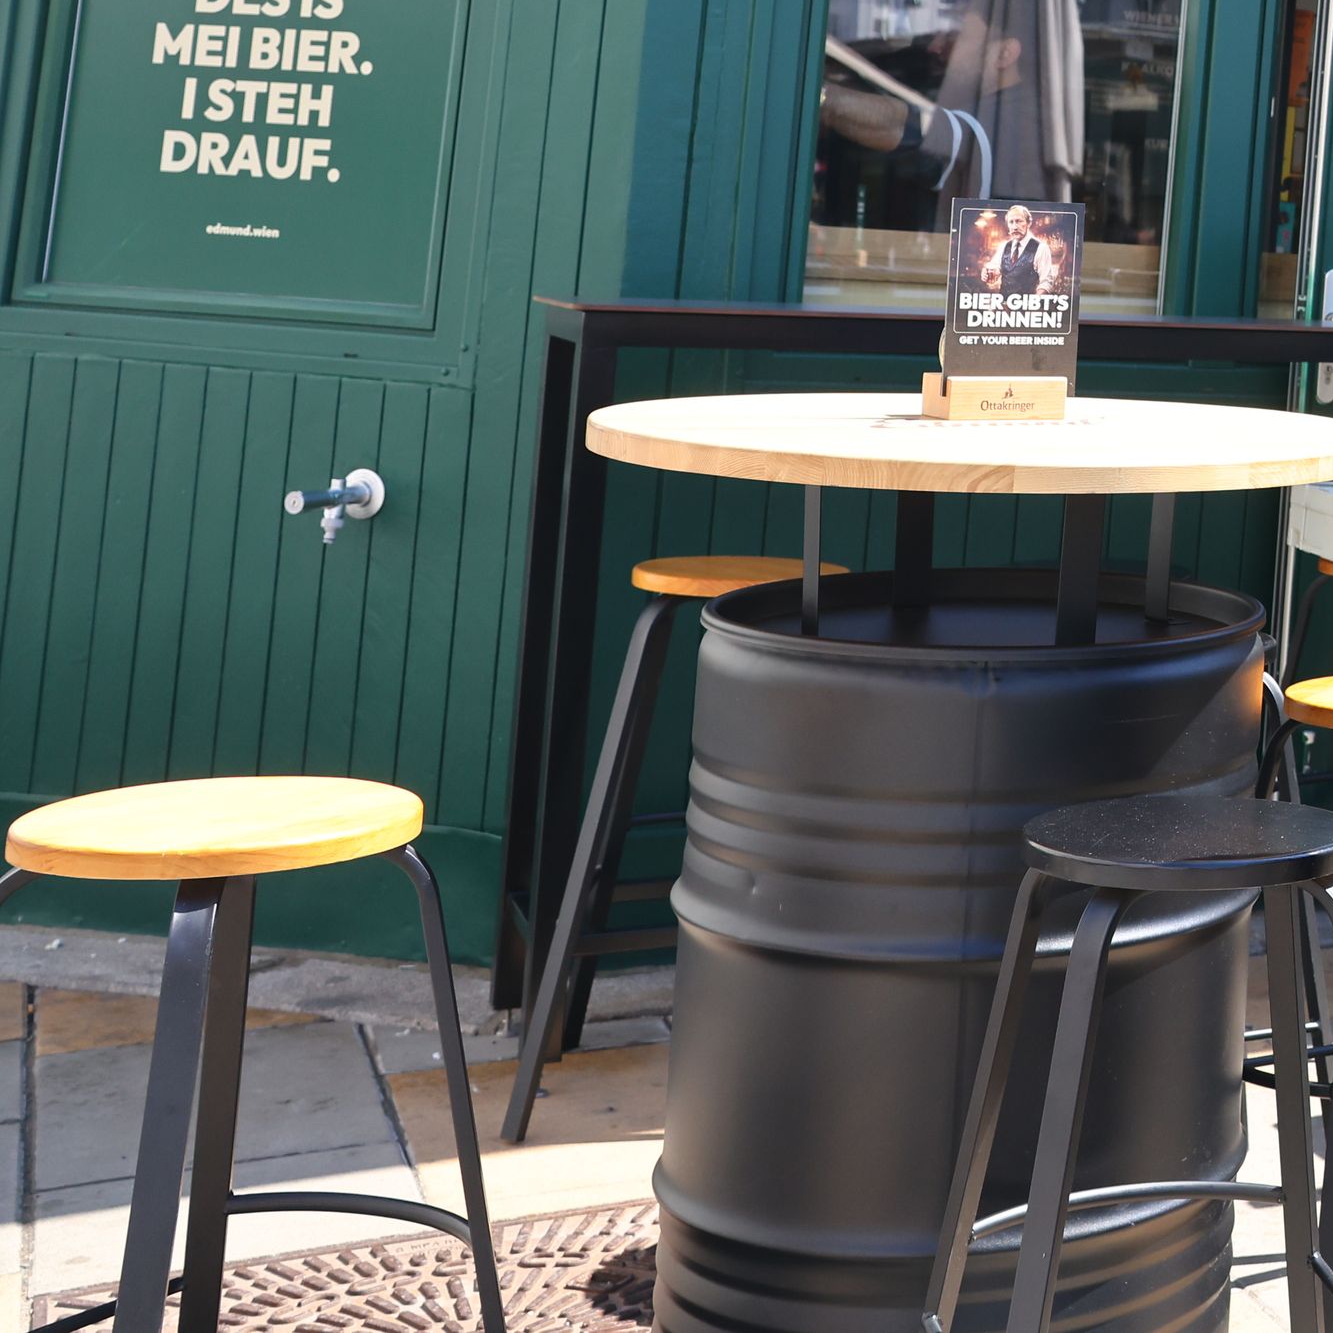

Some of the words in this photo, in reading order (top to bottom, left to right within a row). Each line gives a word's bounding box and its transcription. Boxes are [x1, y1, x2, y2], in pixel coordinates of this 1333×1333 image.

[152, 22, 241, 68] MEI
[249, 27, 373, 75] BIER.
[181, 77, 198, 119] I
[204, 78, 334, 127] STEH
[160, 129, 340, 183] DRAUF.
[206, 223, 280, 239] edmund.wien
[959, 293, 1004, 310] BIER
[1006, 294, 1069, 311] GIBT'S
[967, 311, 1063, 328] DRINNEN!
[959, 336, 979, 345] GET
[981, 336, 1009, 345] YOUR
[1009, 336, 1033, 345] BEER
[1034, 337, 1064, 345] INSIDE
[980, 400, 1036, 412] Ottakringer
